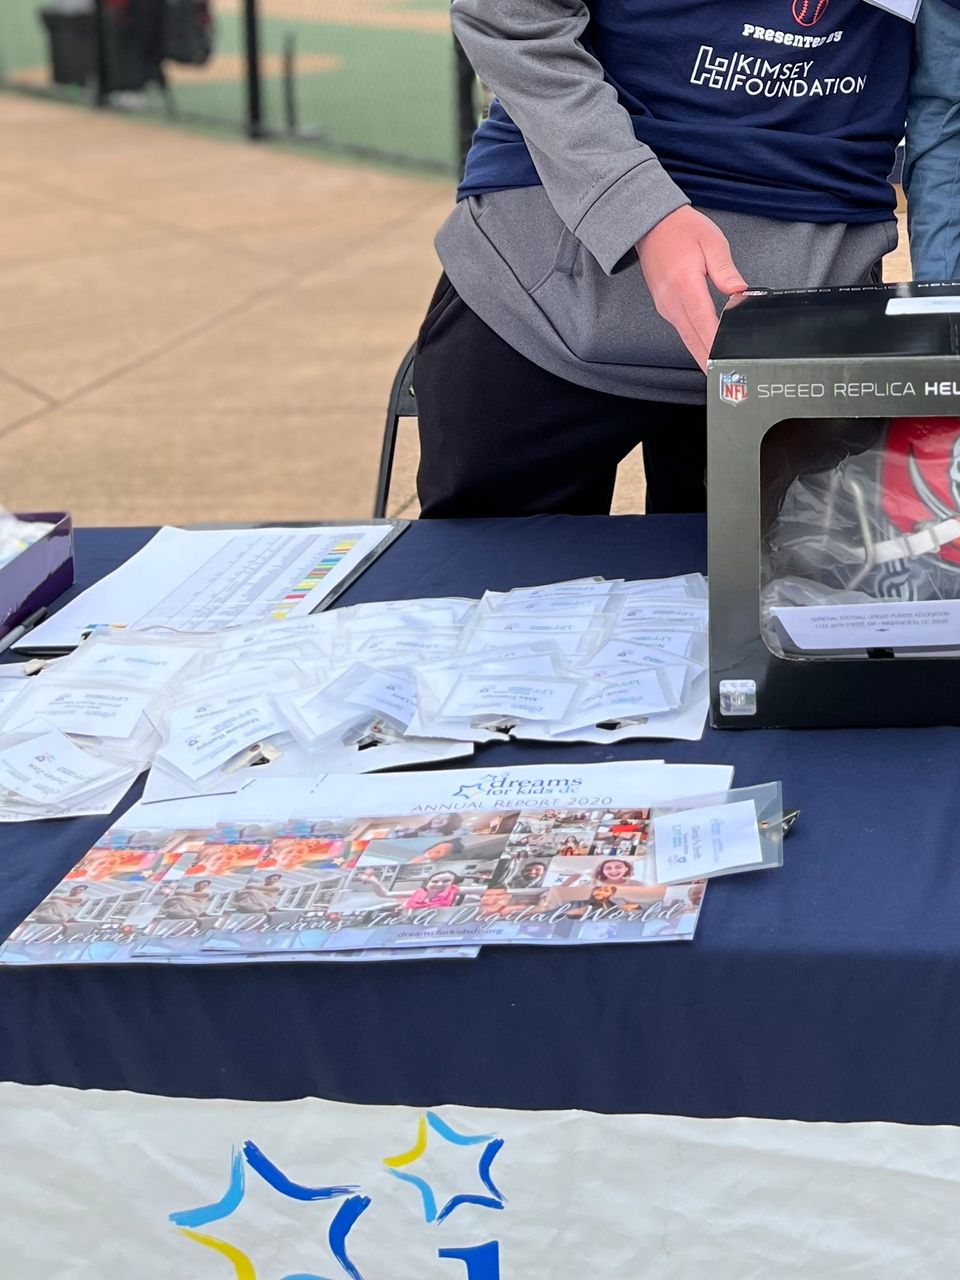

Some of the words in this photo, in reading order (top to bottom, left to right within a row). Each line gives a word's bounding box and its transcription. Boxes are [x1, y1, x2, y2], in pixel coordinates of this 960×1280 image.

[736, 54, 814, 79] KIMSEY
[731, 74, 867, 97] FOUNDATION
[724, 382, 749, 401] NFL
[757, 383, 825, 398] SPEED
[834, 382, 916, 397] REPLICA
[486, 787, 509, 796] for
[516, 786, 554, 795] kids
[561, 785, 581, 794] dc
[490, 776, 583, 789] dreams
[411, 800, 483, 812] ANNUAL
[494, 798, 561, 808] REPORT
[567, 797, 613, 807] 2020
[232, 910, 345, 933] Dreams
[448, 903, 573, 929] Digital
[579, 901, 685, 923] World
